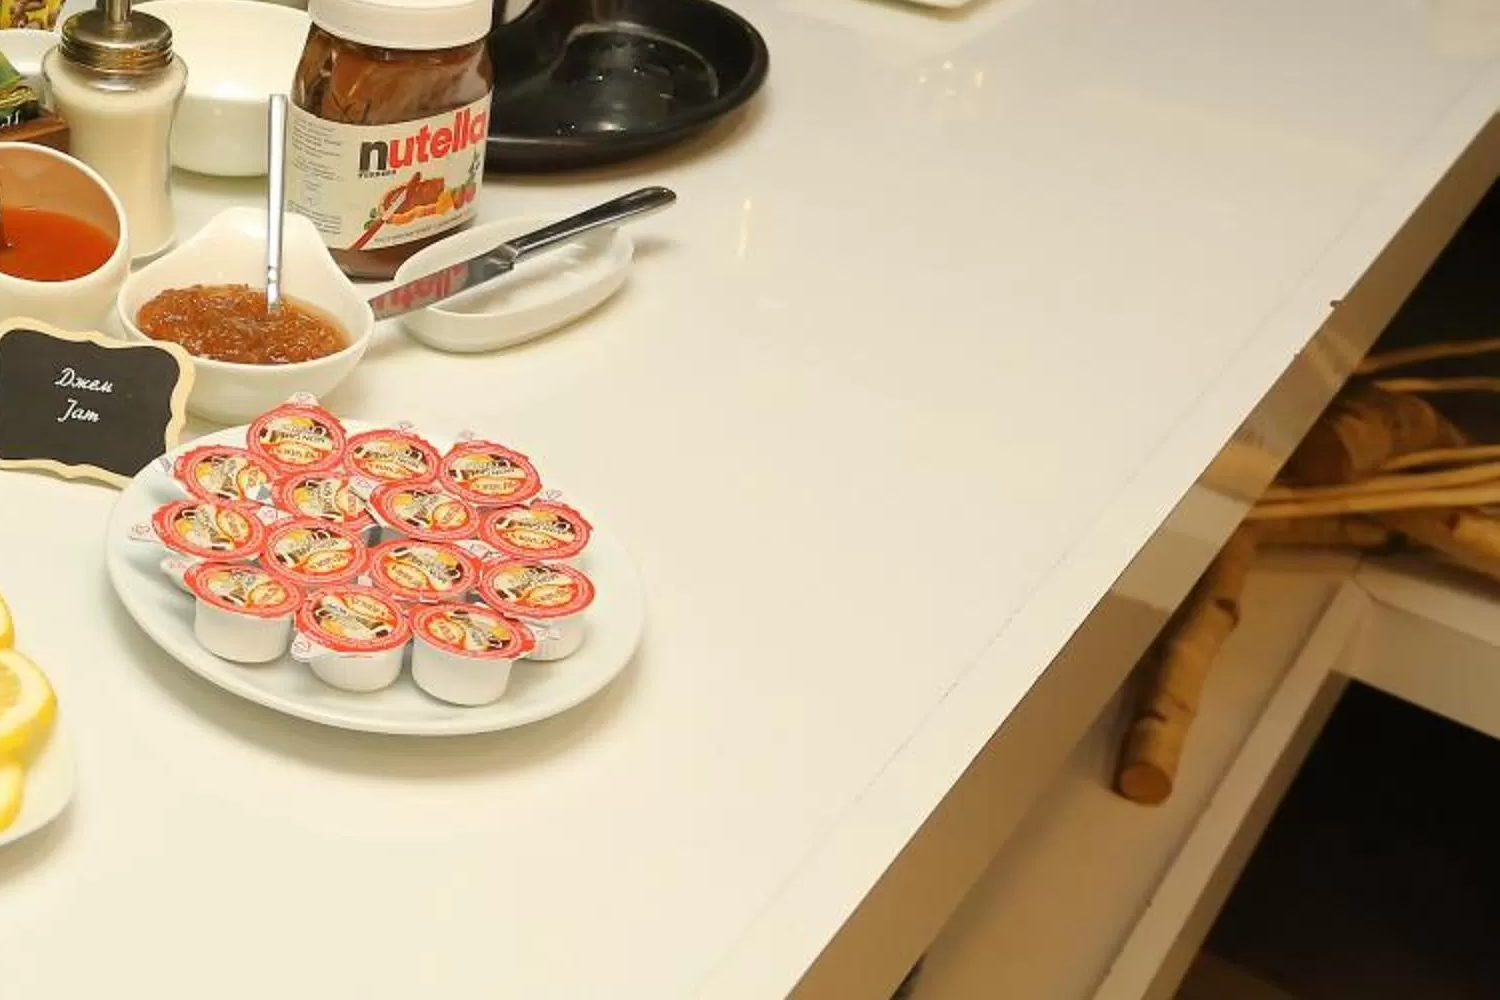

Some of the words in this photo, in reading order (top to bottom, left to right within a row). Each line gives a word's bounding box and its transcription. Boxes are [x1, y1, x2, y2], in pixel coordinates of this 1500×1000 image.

[359, 108, 487, 170] nutella
[54, 367, 113, 393] Джем
[57, 399, 100, 422] Jam
